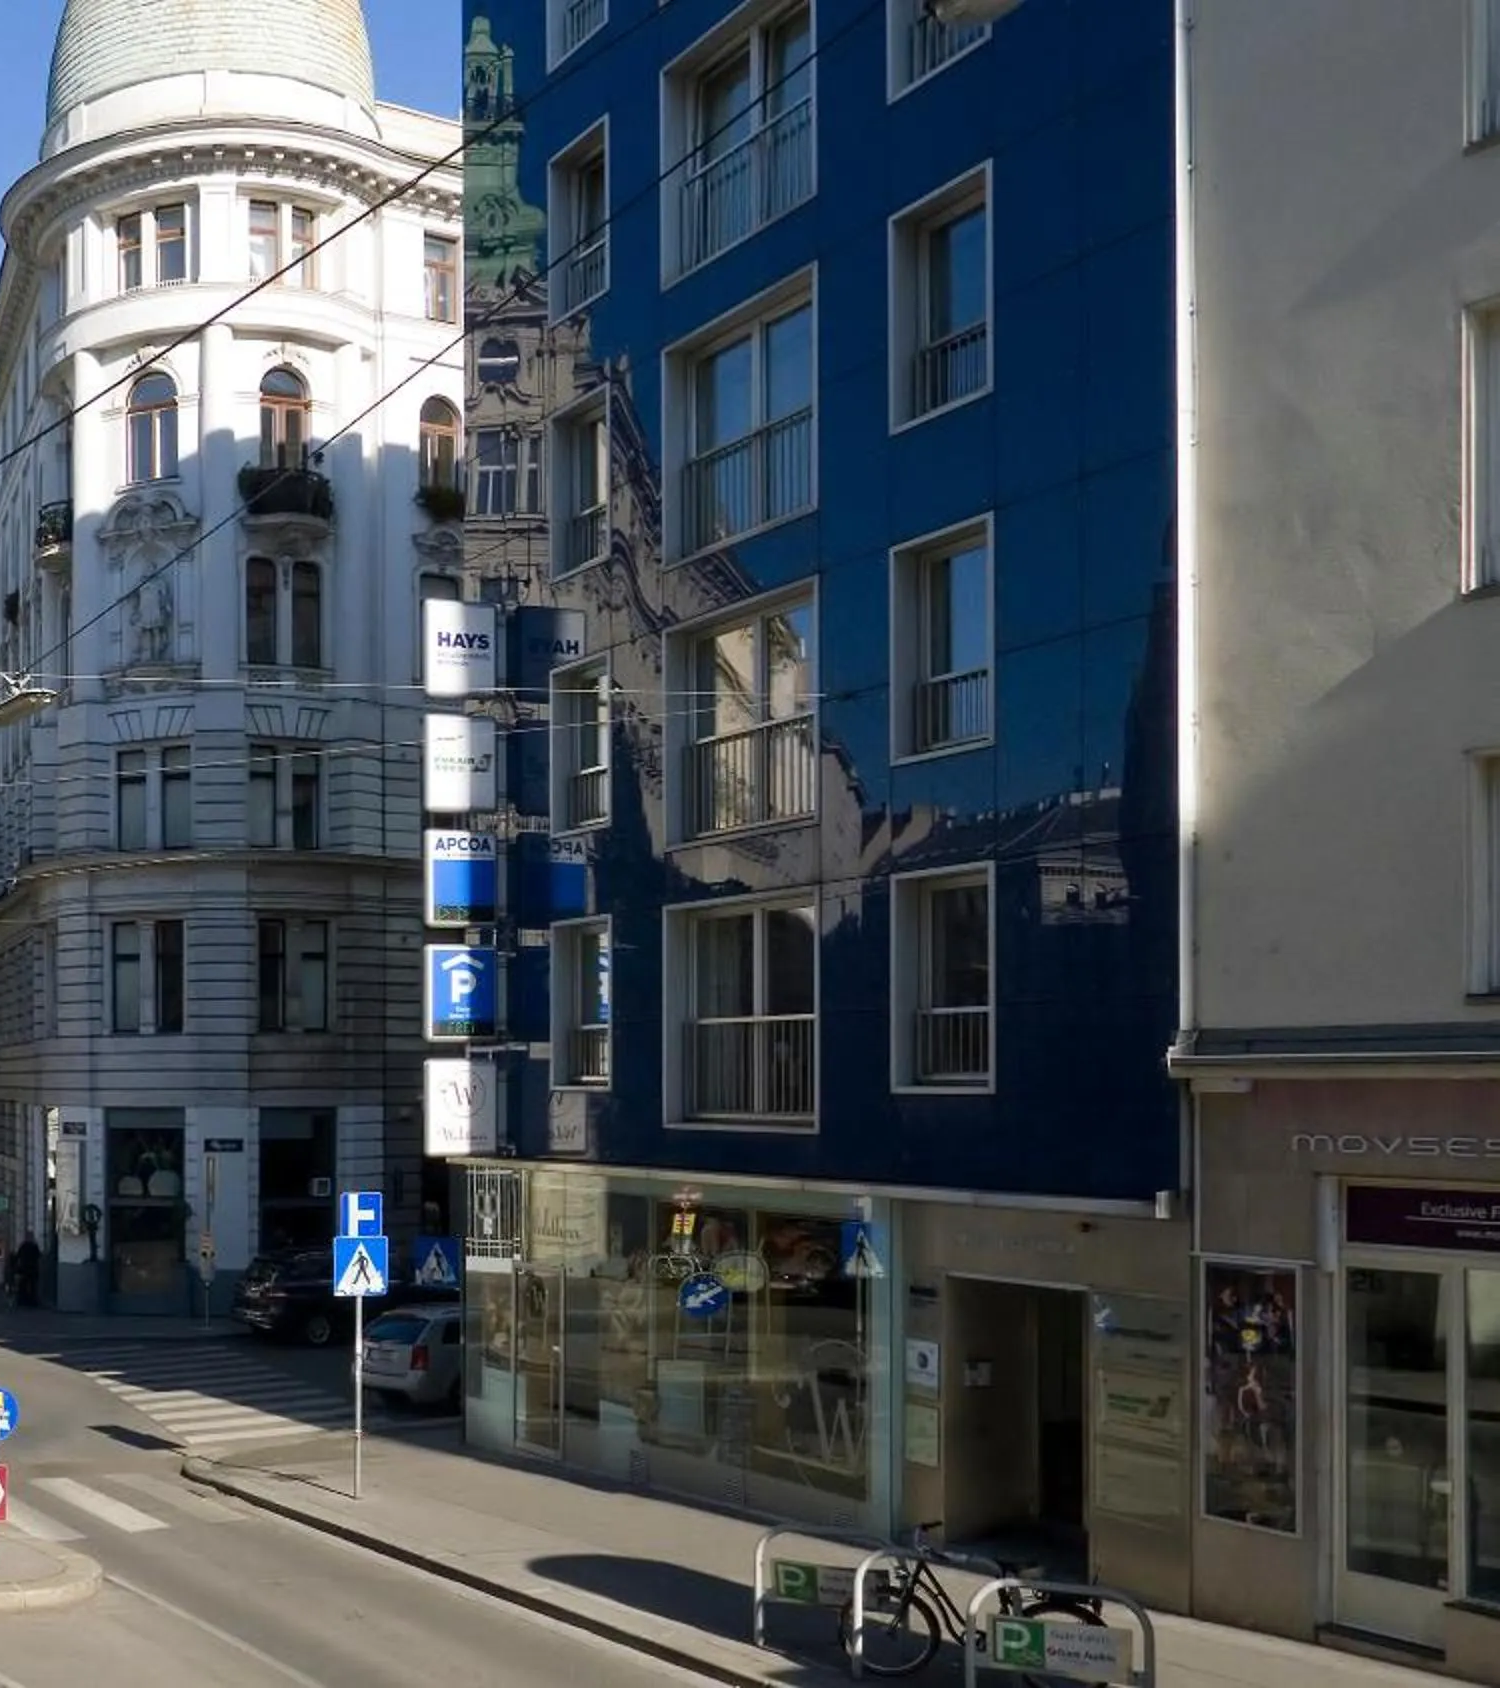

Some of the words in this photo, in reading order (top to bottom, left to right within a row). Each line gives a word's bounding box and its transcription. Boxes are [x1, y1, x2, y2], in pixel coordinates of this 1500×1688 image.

[437, 631, 490, 650] HAYS
[435, 837, 492, 852] APCOA
[451, 969, 477, 1003] P
[1420, 1201, 1487, 1219] Exclusive
[995, 1621, 1031, 1661] P
